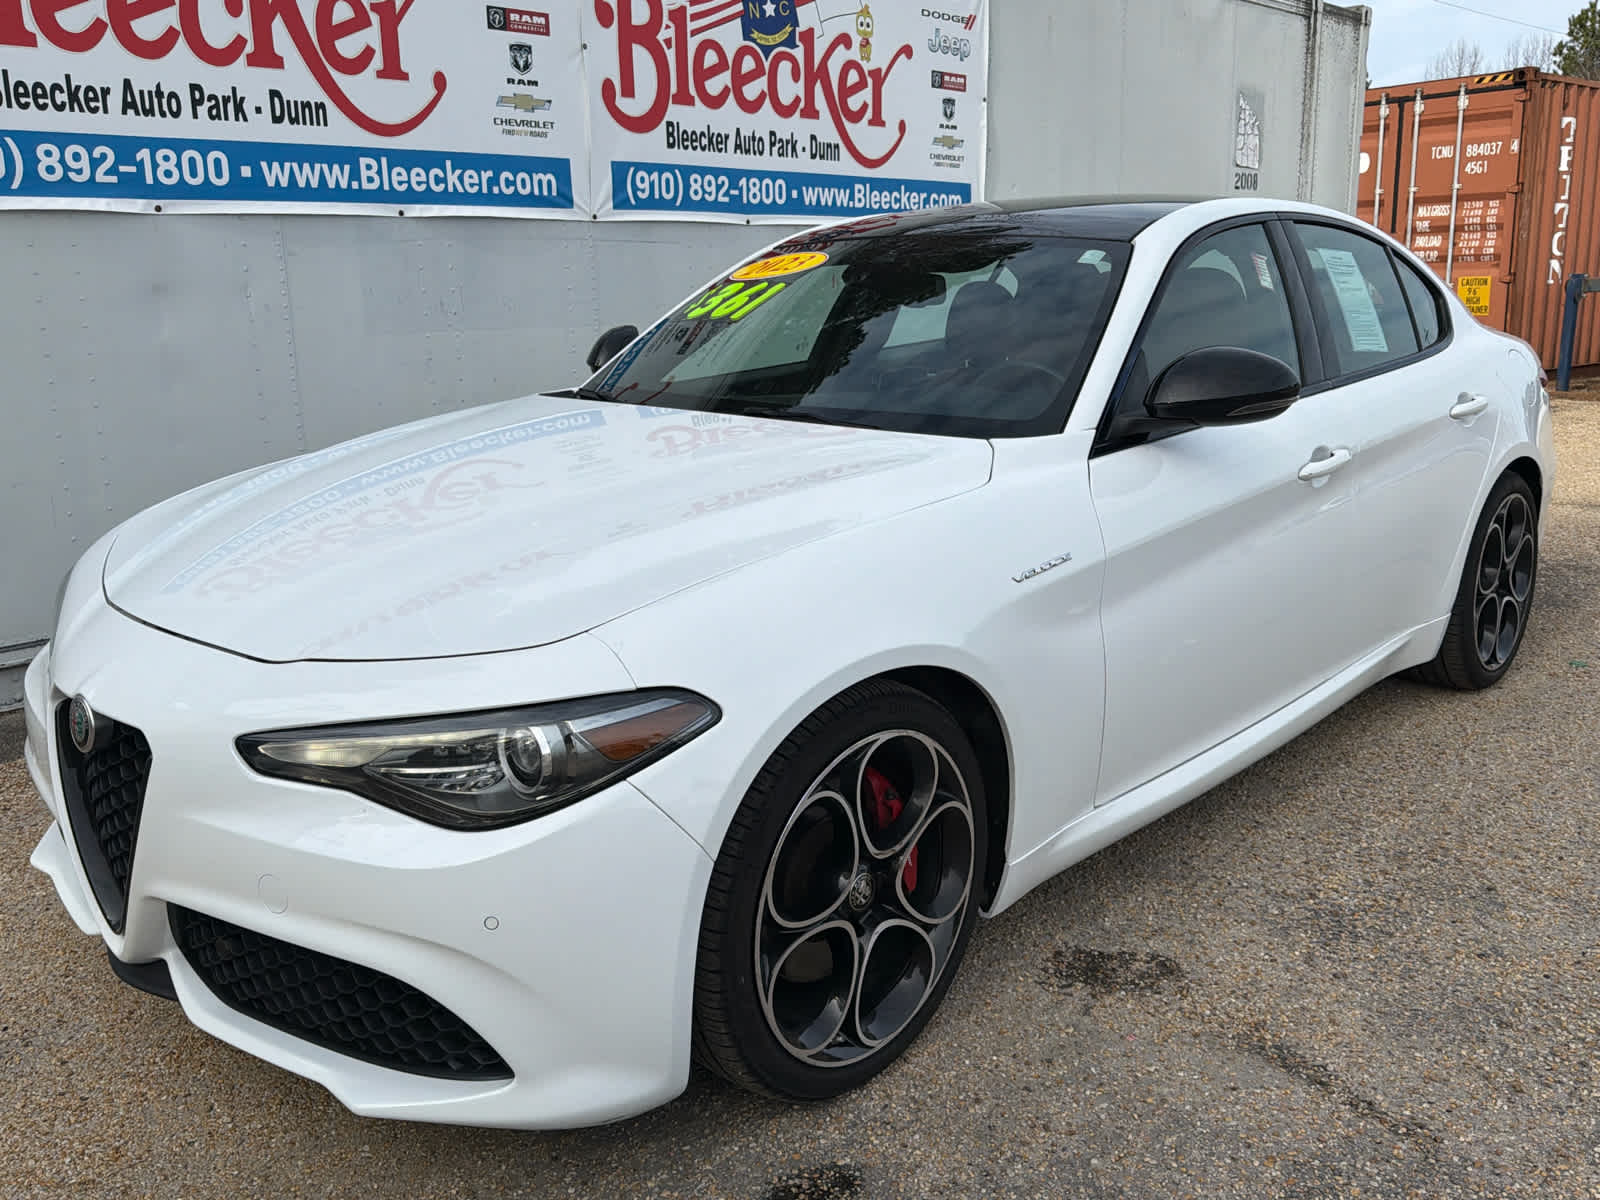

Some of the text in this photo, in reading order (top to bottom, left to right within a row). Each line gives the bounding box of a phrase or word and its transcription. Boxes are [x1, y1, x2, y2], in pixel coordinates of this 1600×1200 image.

[509, 13, 546, 25] RAM
[921, 8, 970, 25] DODGE
[928, 28, 970, 61] Jeep
[506, 78, 539, 87] RAM
[594, 0, 913, 168] Bleecker
[0, 68, 112, 114] leecker
[121, 78, 182, 119] Auto
[189, 83, 248, 122] Park
[268, 88, 328, 127] Dunn
[493, 117, 555, 130] CHEVROLET
[665, 120, 730, 154] Bleecker
[734, 127, 765, 157] Auto
[769, 130, 799, 159] Park
[809, 133, 840, 162] Dunn
[1431, 145, 1454, 159] TCNU
[1465, 141, 1503, 157] 884037
[35, 143, 230, 186] 892-1800
[260, 156, 558, 197] www.Bleecker.com
[1464, 161, 1488, 174] 45G1
[626, 166, 683, 207] (910)
[689, 173, 787, 205] 892-1800
[802, 184, 962, 210] www.Bleecker.com
[1234, 172, 1258, 191] 2008
[1461, 278, 1489, 287] CAUTION
[1011, 551, 1073, 583] VELOCE
